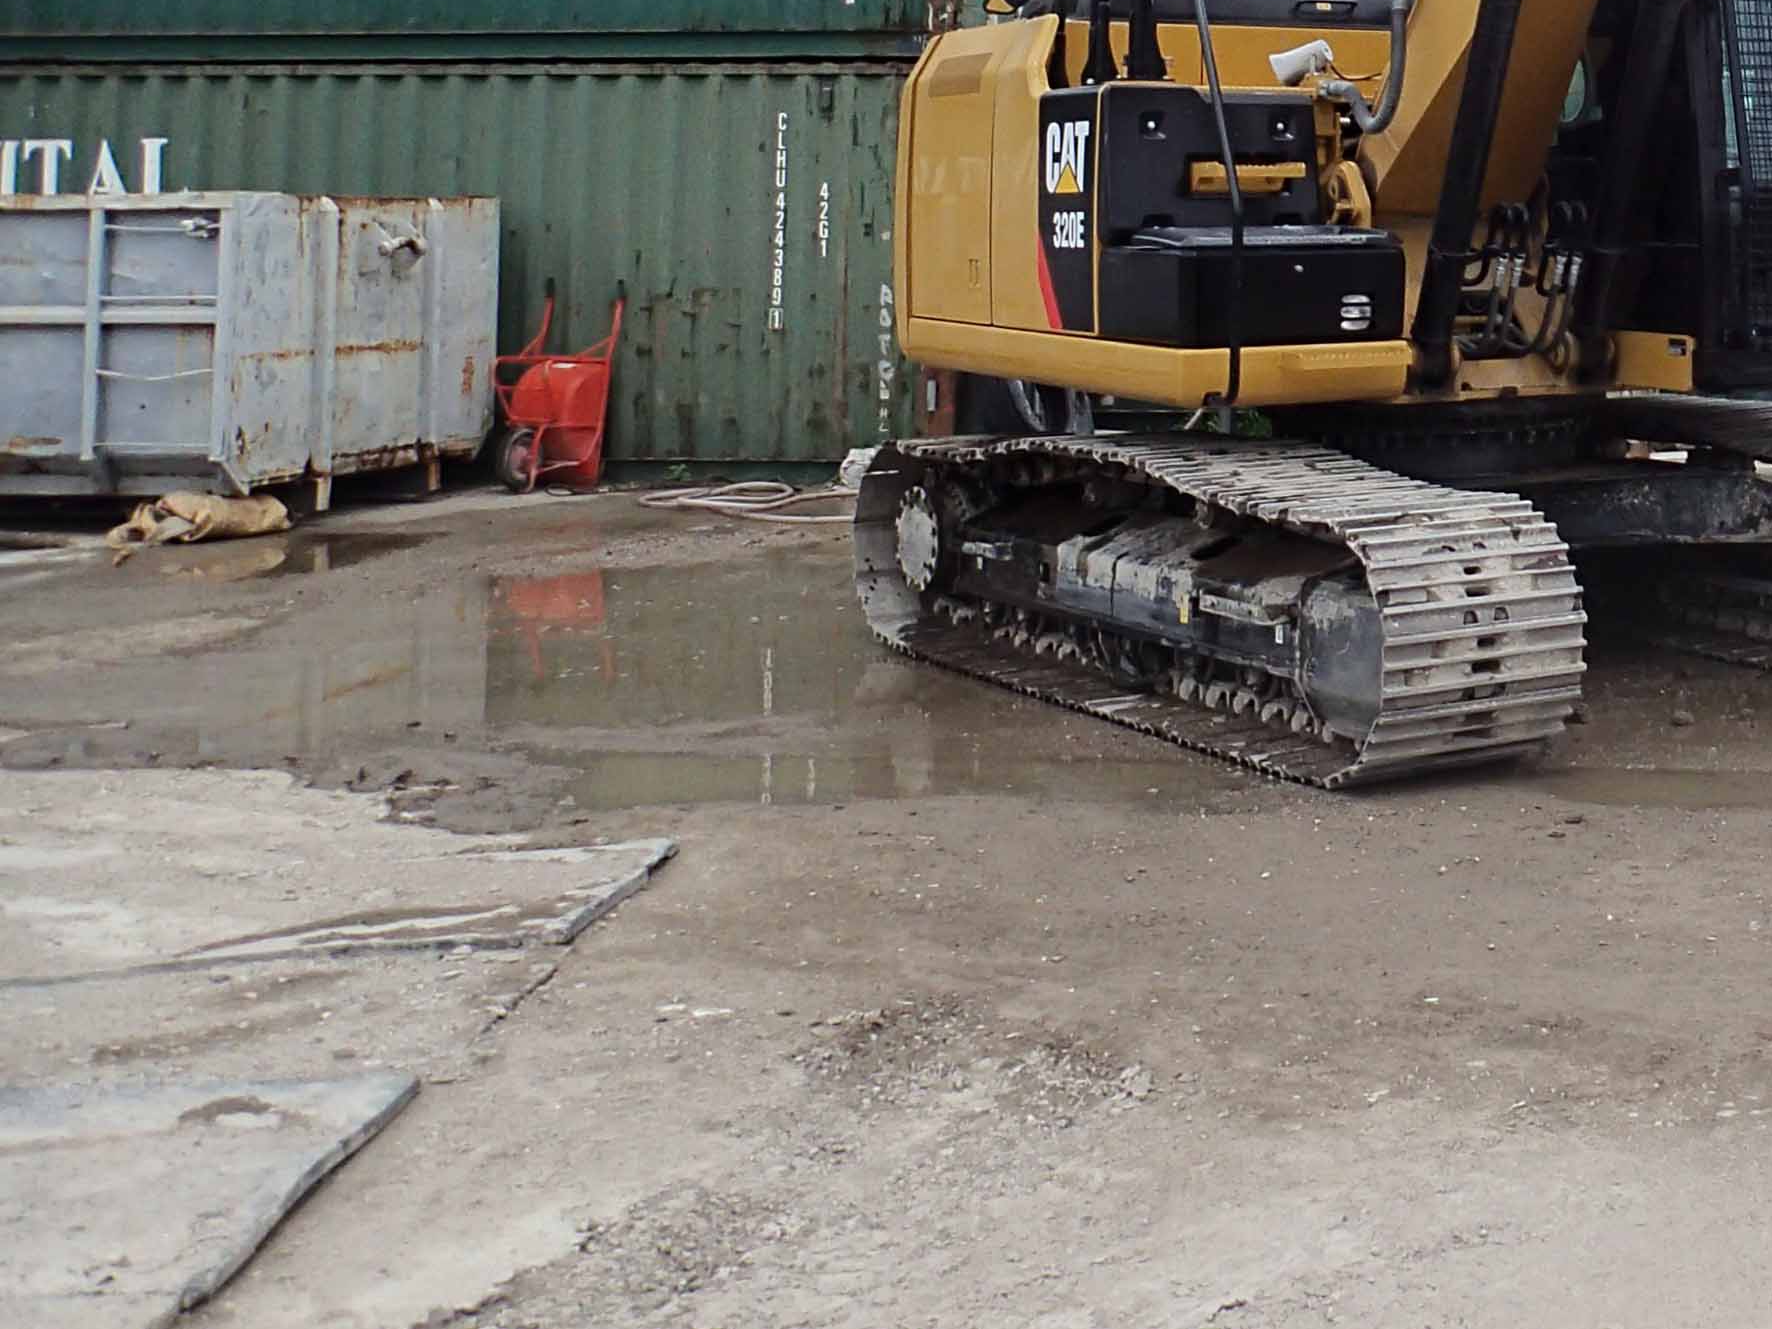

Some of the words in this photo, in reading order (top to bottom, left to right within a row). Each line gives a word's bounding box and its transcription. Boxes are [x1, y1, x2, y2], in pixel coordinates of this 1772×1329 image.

[1046, 120, 1090, 194] CAT
[771, 191, 785, 306] 424389
[818, 181, 830, 257] 42G1
[1053, 211, 1085, 249] 320E
